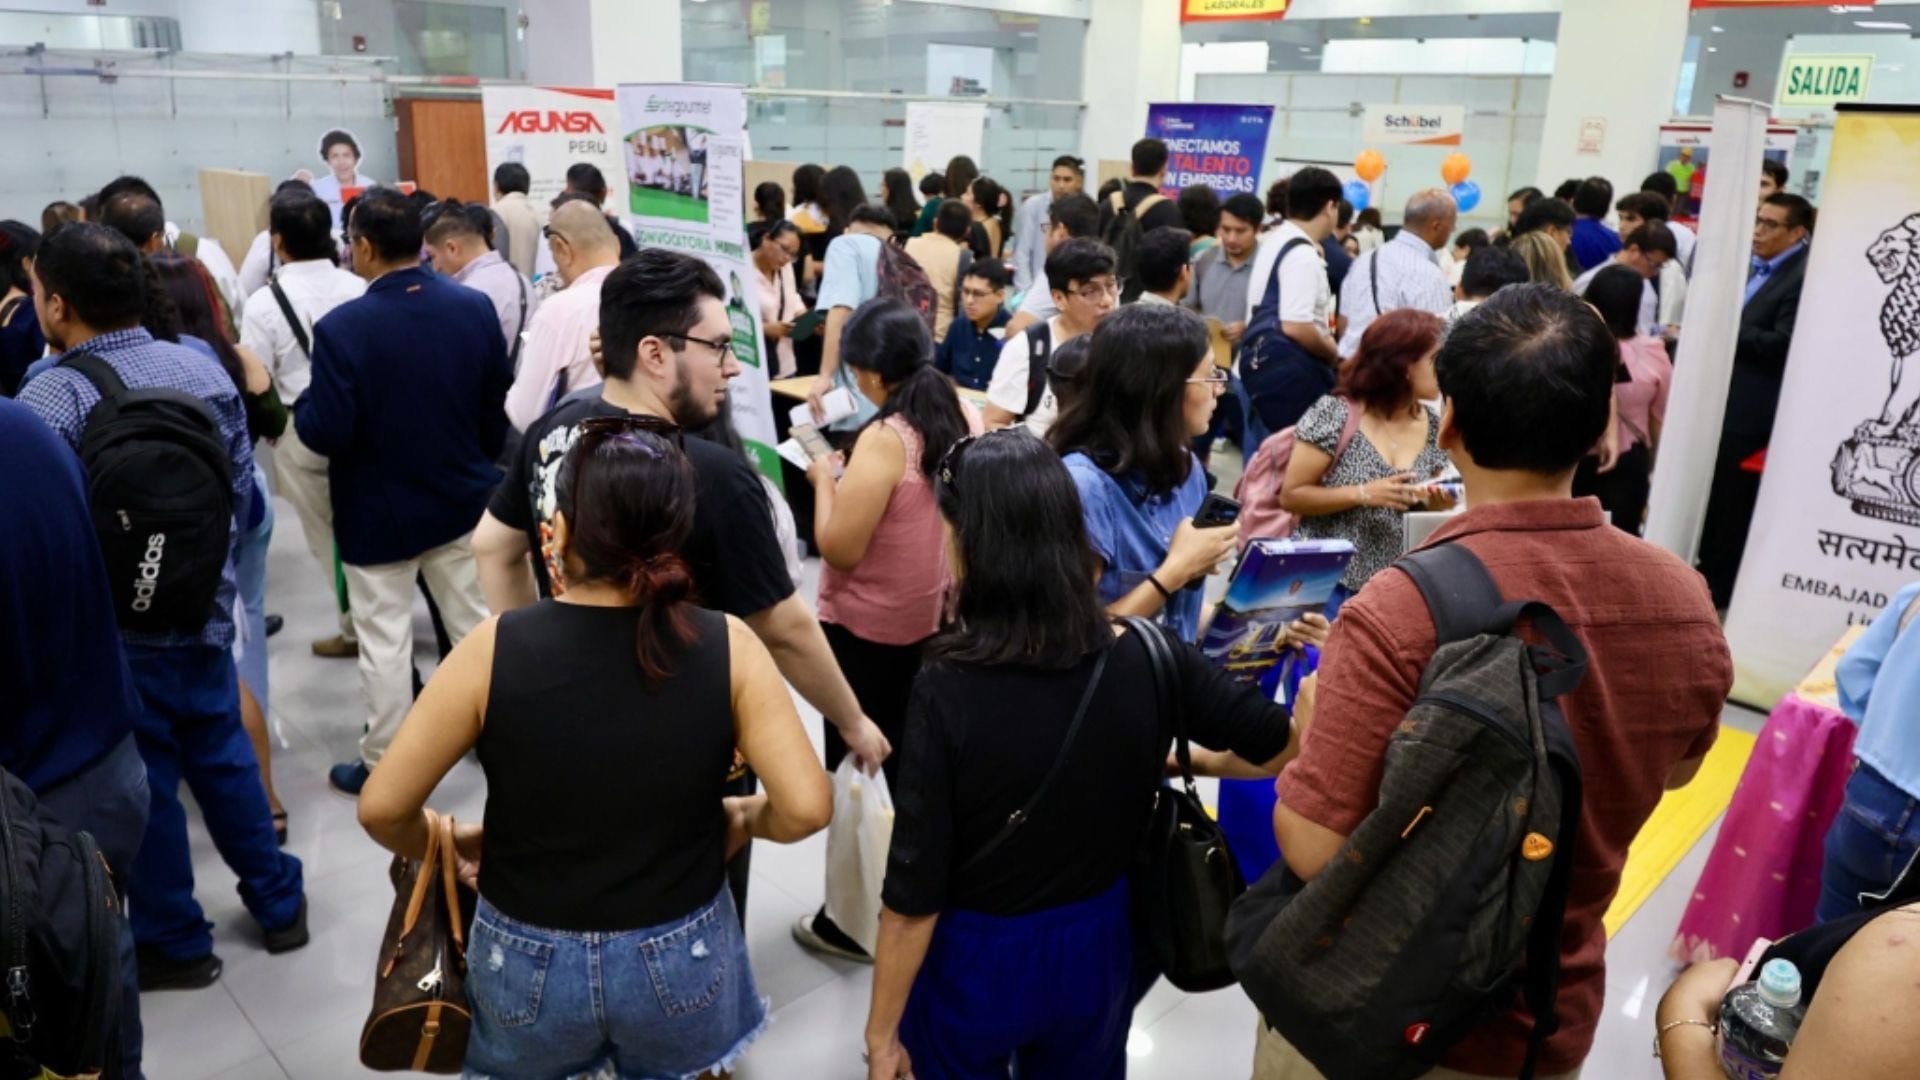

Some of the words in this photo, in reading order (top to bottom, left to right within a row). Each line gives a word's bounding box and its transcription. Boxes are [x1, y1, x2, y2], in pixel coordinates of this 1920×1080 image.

[1788, 66, 1860, 96] SALIDA
[496, 111, 606, 134] AGUNSA
[1162, 138, 1241, 155] NECTAMOS
[1174, 152, 1250, 176] TALENTO
[1179, 173, 1255, 193] EMPRESAS
[131, 533, 165, 611] adidas
[1781, 573, 1888, 609] EMBAJAD
